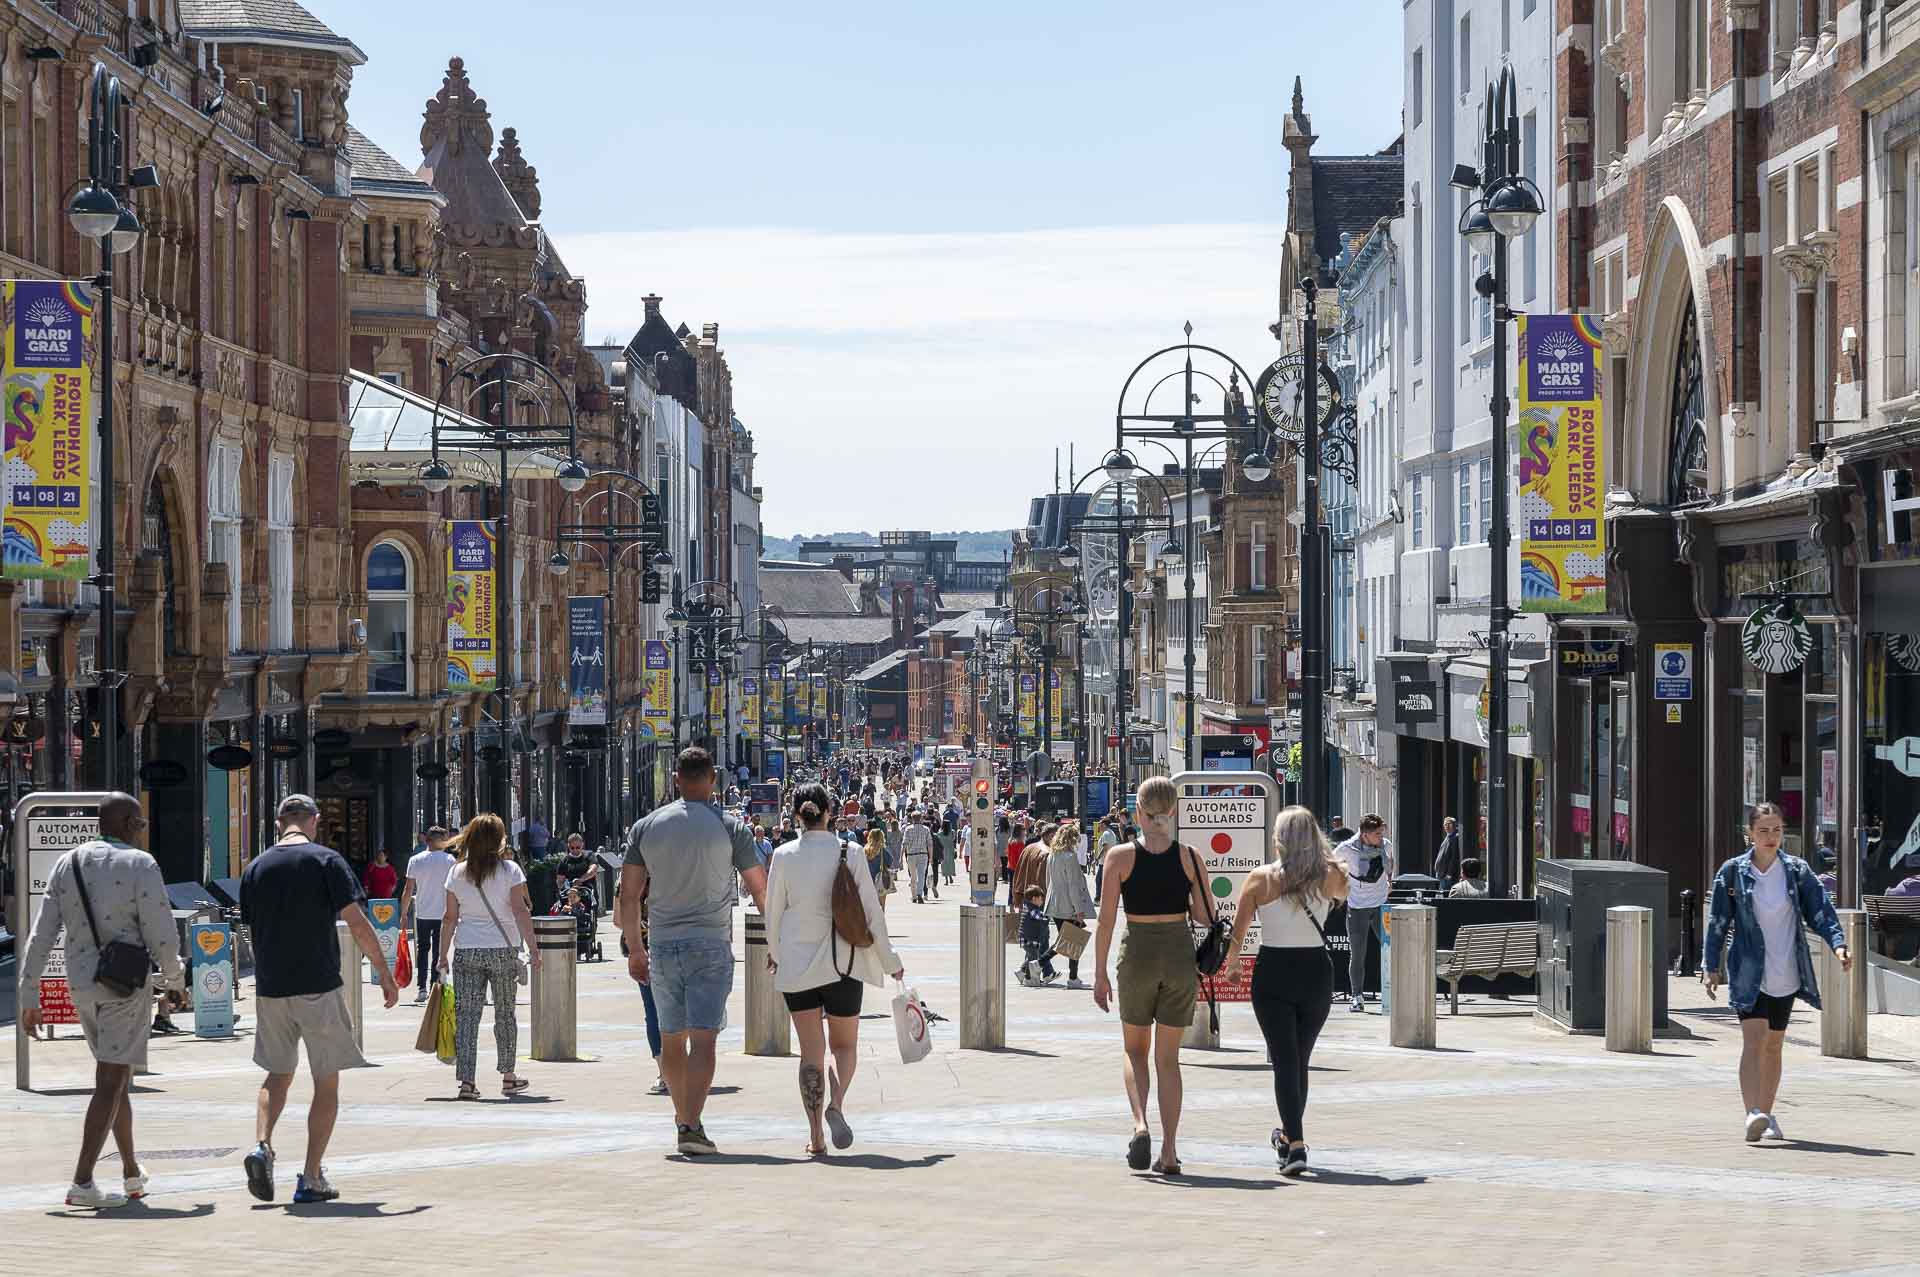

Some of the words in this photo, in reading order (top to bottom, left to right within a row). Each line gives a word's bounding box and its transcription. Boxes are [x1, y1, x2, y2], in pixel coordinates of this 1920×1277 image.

[24, 328, 72, 340] MARDI
[28, 341, 68, 352] GRAS
[1273, 355, 1304, 370] QUEEN
[1538, 362, 1584, 374] MARDI
[1541, 374, 1580, 386] GRAS
[1280, 430, 1304, 442] ARCA
[53, 430, 66, 480] LEEDS
[1568, 463, 1581, 514] LEEDS
[17, 491, 31, 501] 14
[38, 491, 55, 501] 08
[64, 491, 76, 502] 21
[1534, 525, 1548, 536] 14
[1555, 524, 1570, 536] 08
[1579, 524, 1592, 535] 21
[647, 499, 657, 600] DENHAMS
[710, 607, 724, 617] JD
[1563, 650, 1616, 664] Dune
[1186, 802, 1256, 812] AUTOMATIC
[1190, 814, 1253, 824] BOLLARDS
[37, 824, 98, 833] AUTOMATI
[40, 836, 95, 844] BOLLAR
[1206, 858, 1218, 867] ed
[1228, 857, 1260, 868] Rising
[33, 880, 47, 888] Ra
[1217, 902, 1236, 910] Veh
[1220, 985, 1244, 993] comply
